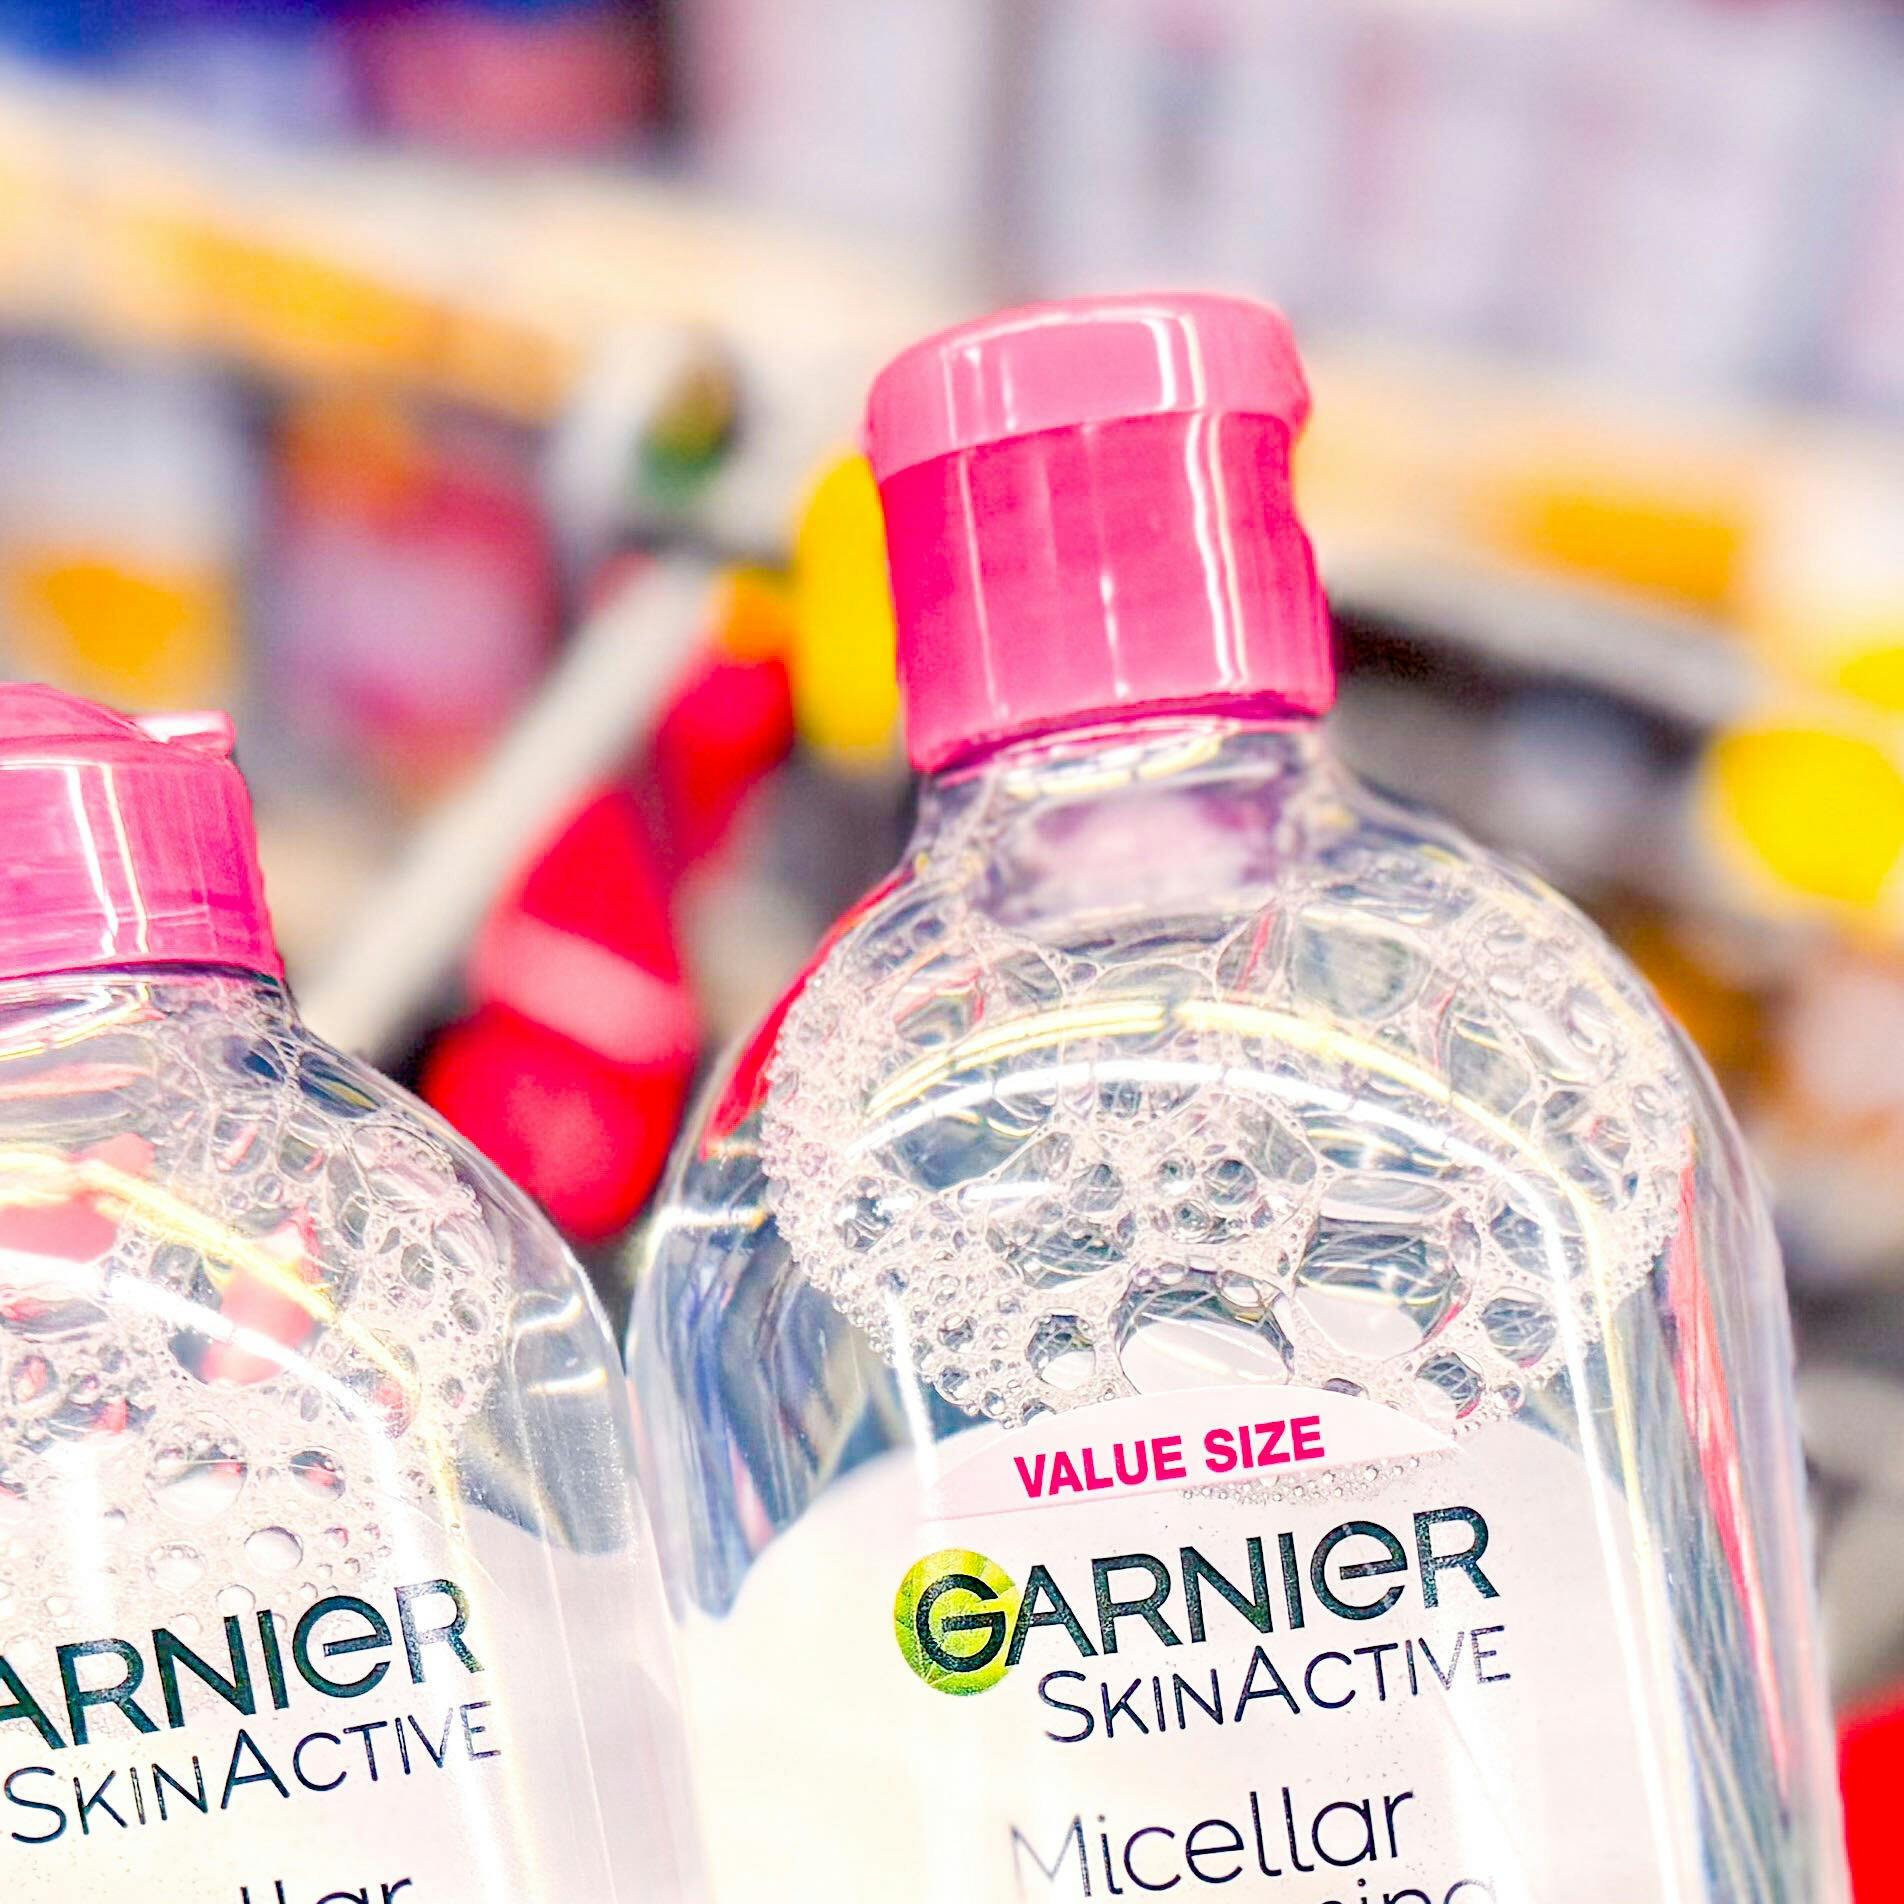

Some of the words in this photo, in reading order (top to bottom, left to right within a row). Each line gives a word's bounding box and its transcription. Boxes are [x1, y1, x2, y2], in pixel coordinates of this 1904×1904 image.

[1014, 1435, 1186, 1498] VALUE
[1204, 1416, 1325, 1468] SIZE
[916, 1506, 1499, 1672] GARNIER
[1010, 1787, 1413, 1897] Micellar
